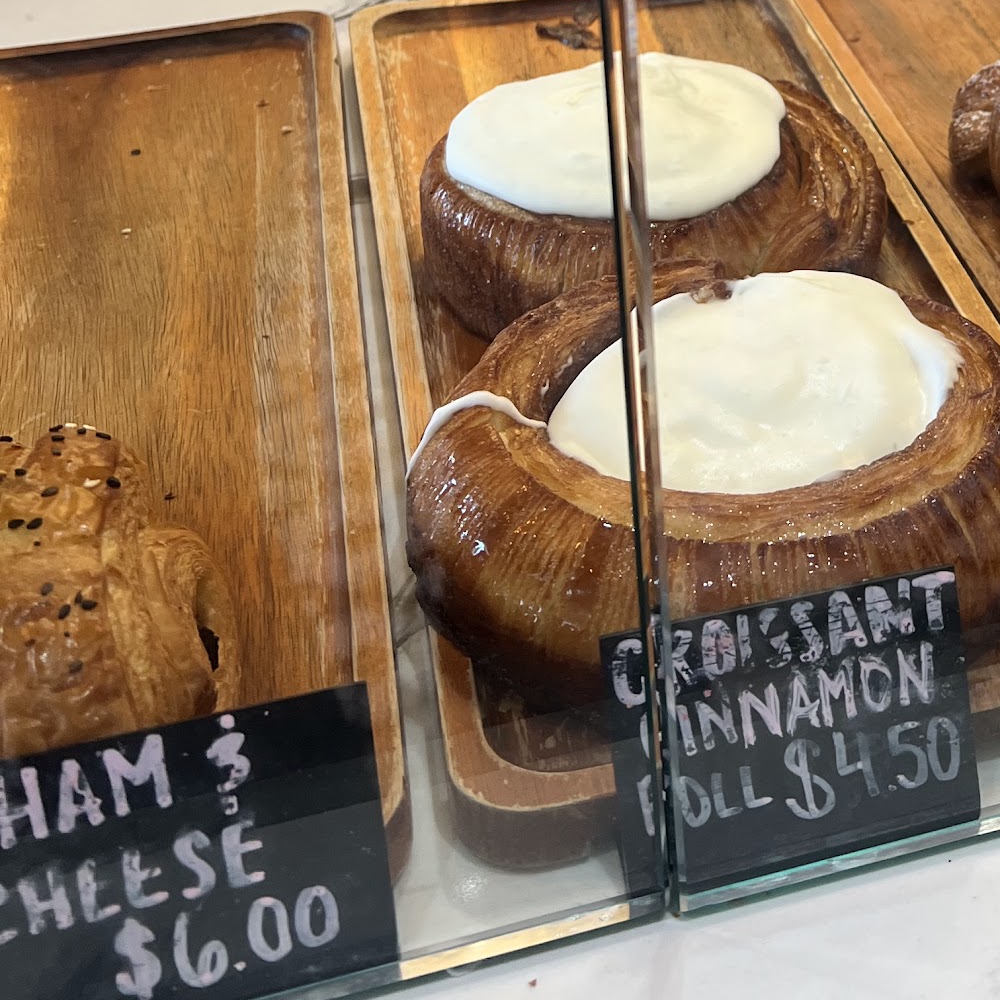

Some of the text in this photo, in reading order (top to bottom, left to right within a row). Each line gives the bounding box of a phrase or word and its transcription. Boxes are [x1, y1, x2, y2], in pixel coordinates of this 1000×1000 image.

[612, 571, 955, 708] CROISSANT
[0, 734, 173, 849] HAM
[784, 717, 961, 820] $4.50
[115, 885, 340, 999] $6.00
